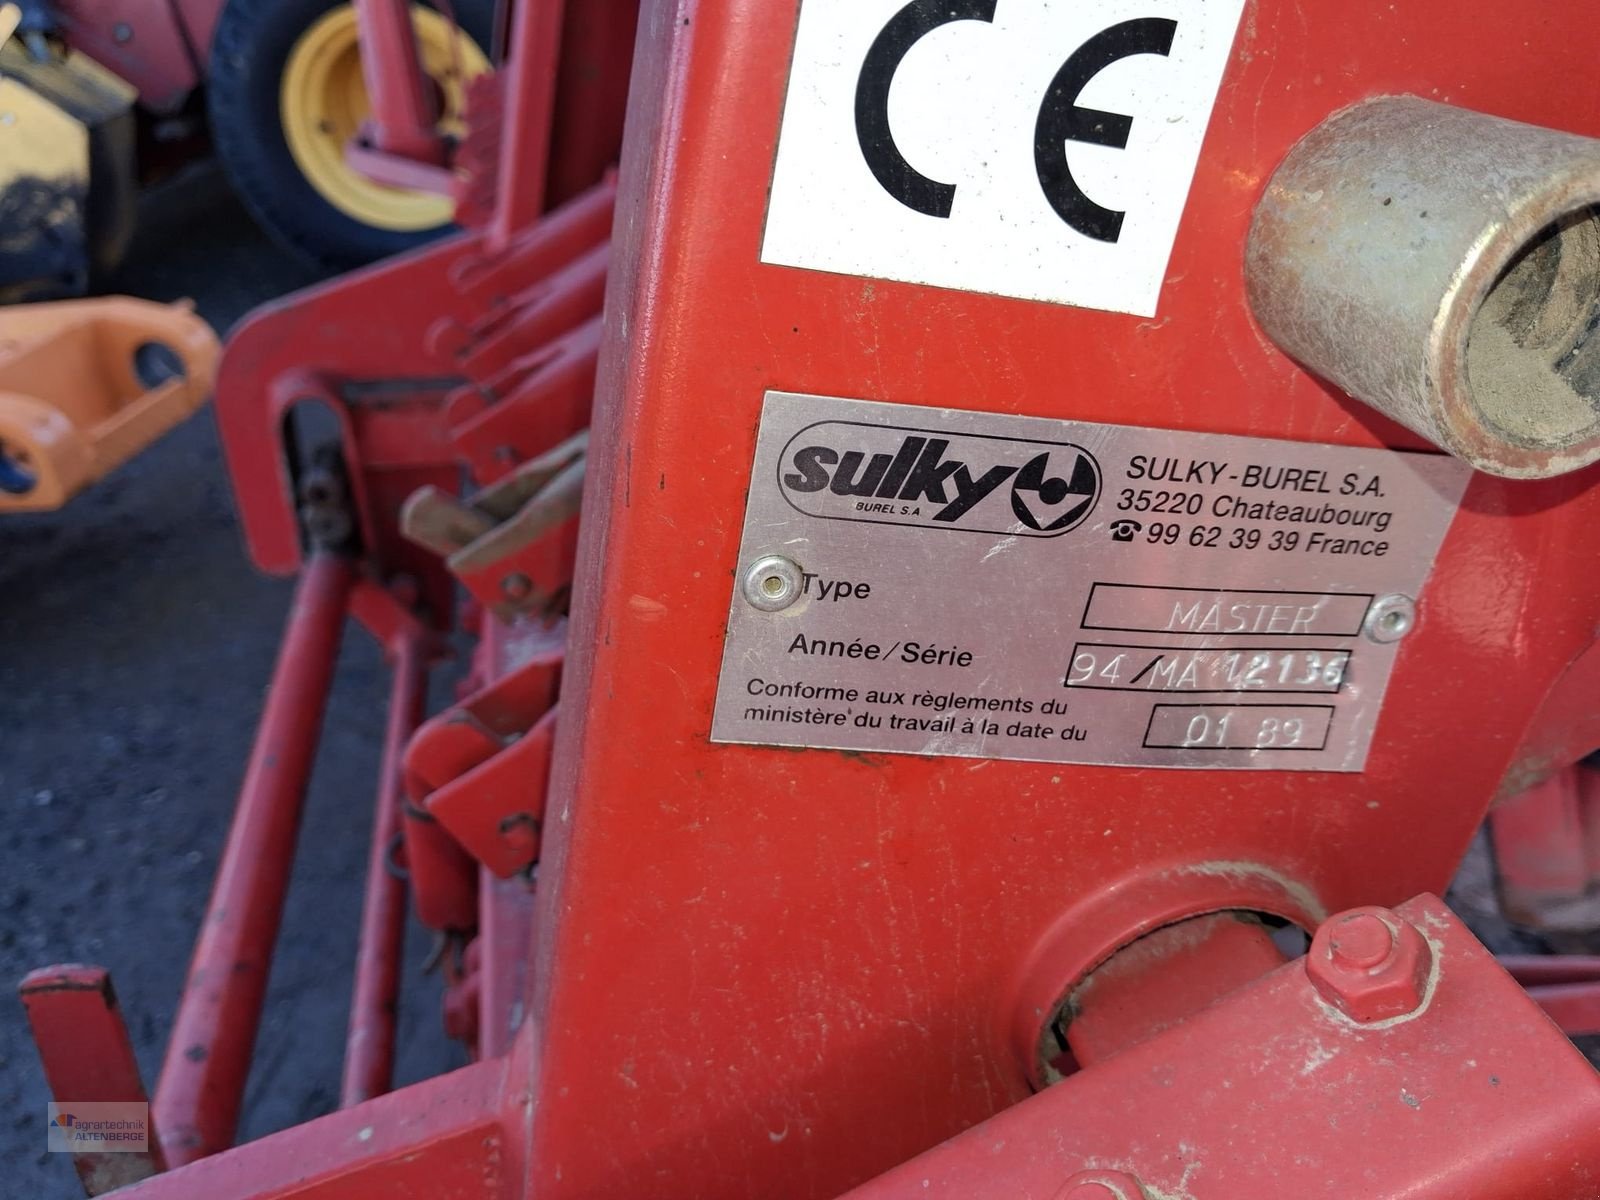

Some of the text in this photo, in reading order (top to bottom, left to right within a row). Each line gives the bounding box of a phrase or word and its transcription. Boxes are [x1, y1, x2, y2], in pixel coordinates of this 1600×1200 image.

[855, 0, 1177, 243] CE
[784, 436, 1020, 522] sulky
[1339, 473, 1385, 497] S.A.
[855, 502, 896, 514] BUREL
[1116, 488, 1392, 532] 35220 Chateaubourg
[1146, 522, 1389, 557] 99 62 39 39 France
[802, 573, 871, 602] Type
[1167, 601, 1318, 634] MASTER
[787, 632, 973, 668] Année/Série
[747, 678, 1068, 716] Conforme aux règlements du
[744, 705, 1087, 741] ministère du travail à la date du
[1185, 713, 1304, 746] 01 89
